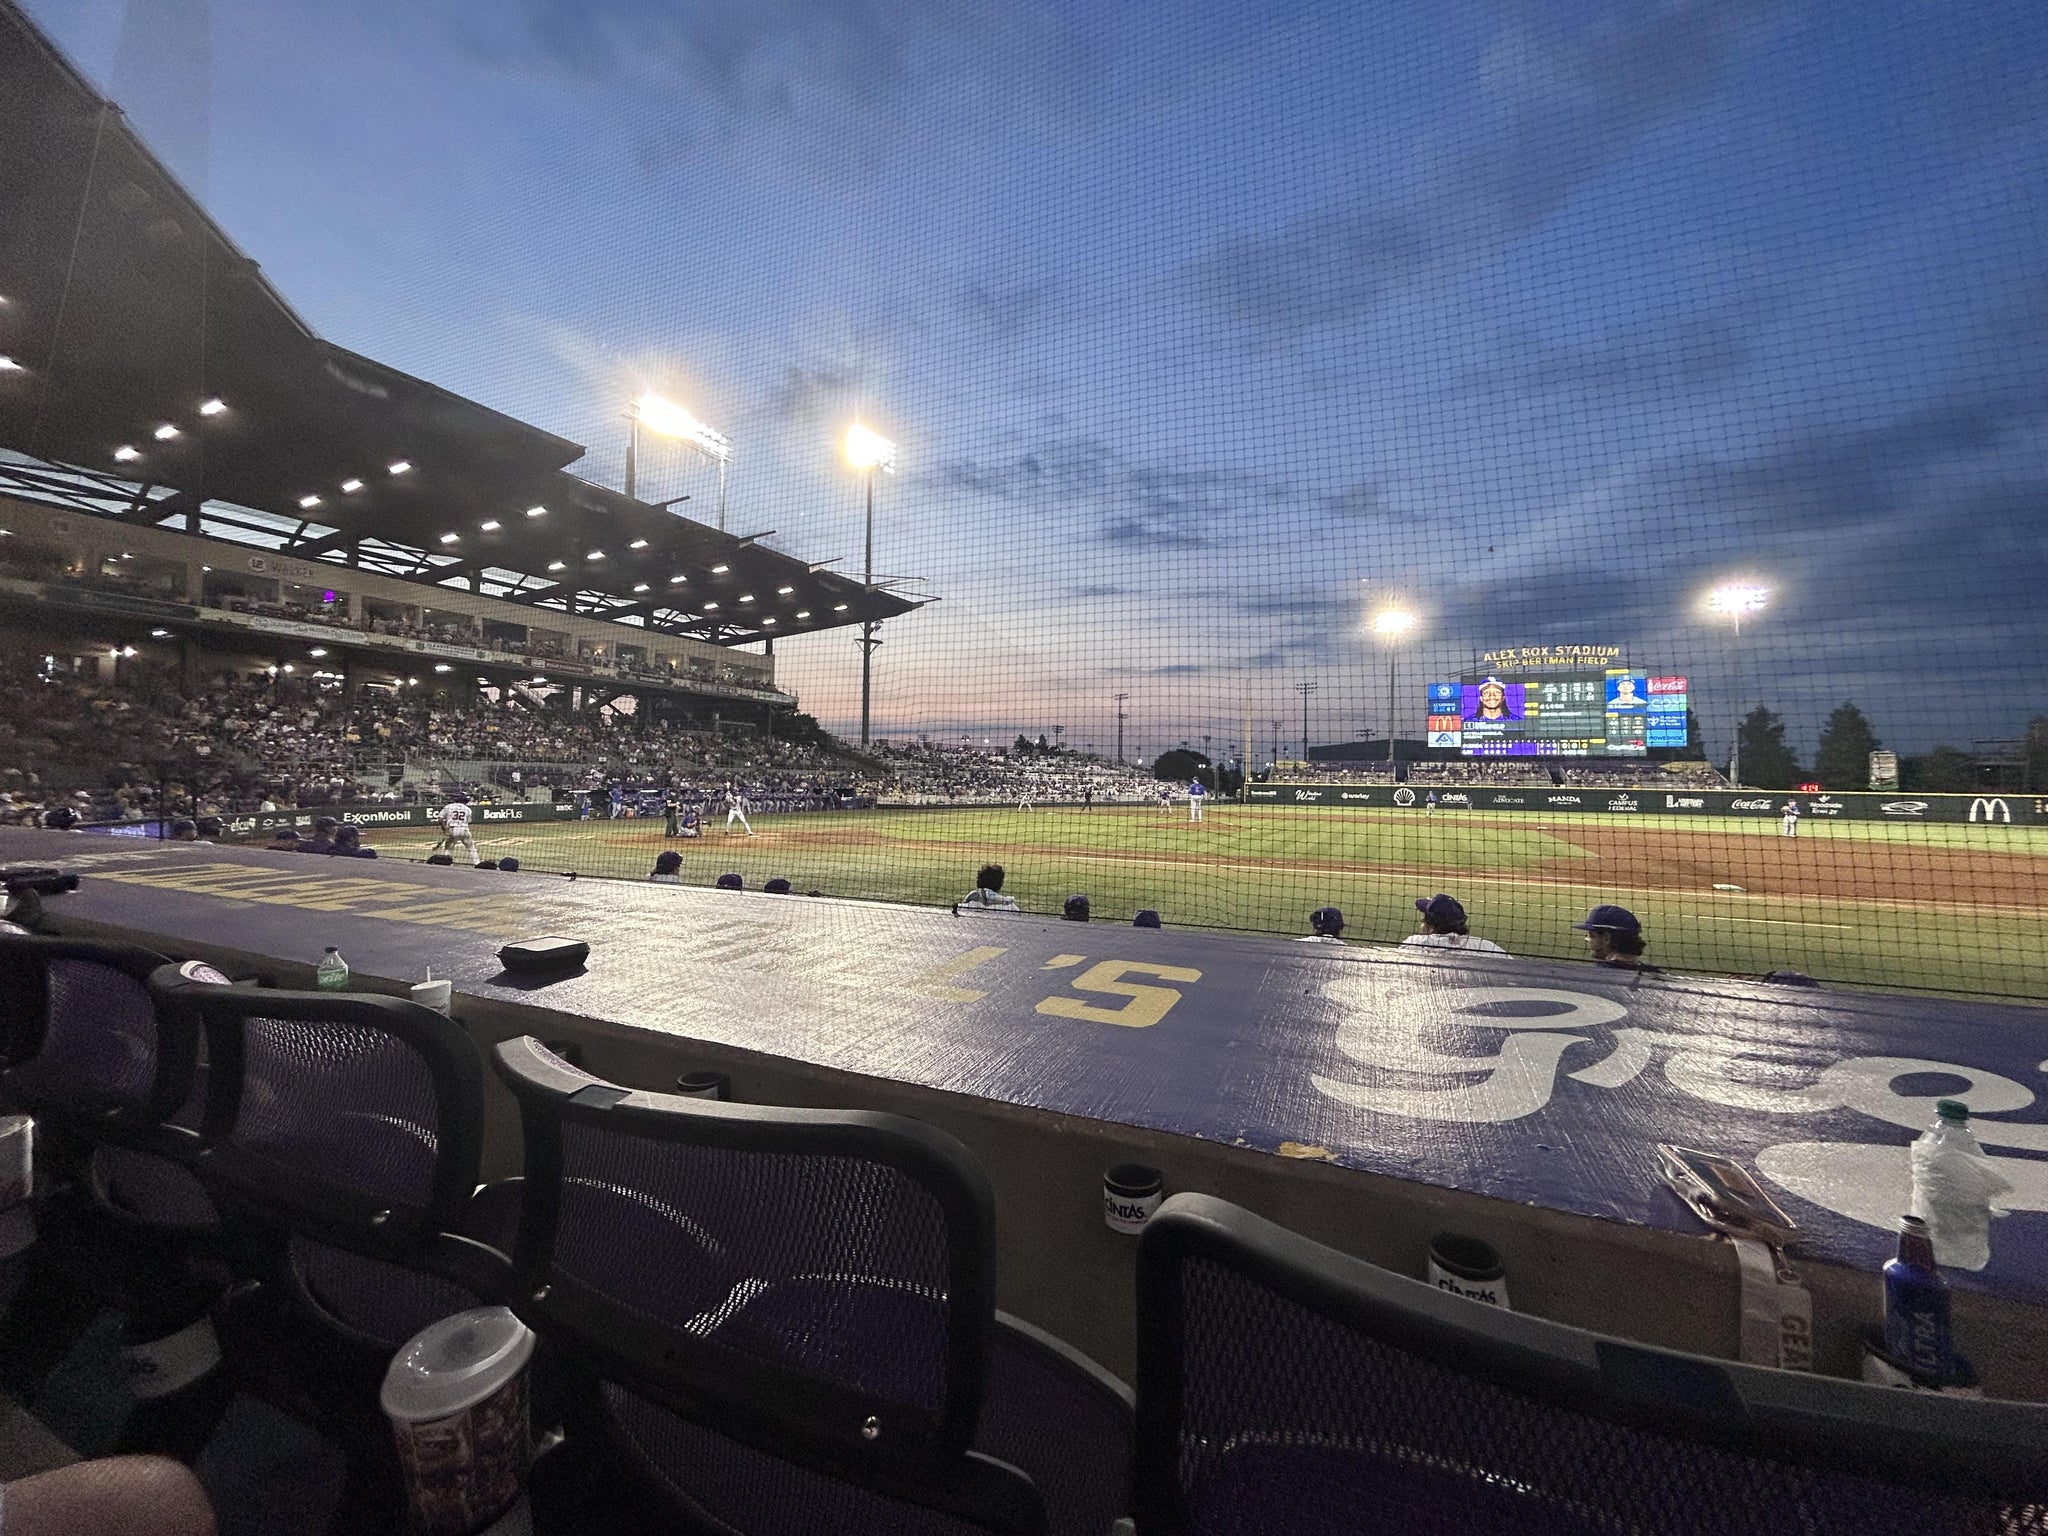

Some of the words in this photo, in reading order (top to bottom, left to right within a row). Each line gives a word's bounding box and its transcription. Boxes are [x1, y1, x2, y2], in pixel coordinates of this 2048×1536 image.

[1484, 649, 1516, 662] ALEX
[1522, 647, 1549, 657] BOX
[1555, 645, 1620, 657] STADIUM
[1496, 659, 1519, 669] SKIP
[1522, 656, 1574, 666] BERTMAN
[1577, 656, 1608, 665] FIELD
[1413, 761, 1444, 770] LEFT
[1446, 761, 1480, 771] FIELD
[1492, 796, 1525, 804] ADVOCATE
[1547, 795, 1581, 804] MANDA
[1731, 798, 1773, 810] Coca-Cola
[343, 810, 411, 824] ExxonMobil
[452, 811, 465, 821] 32
[483, 808, 523, 819] BankPlus
